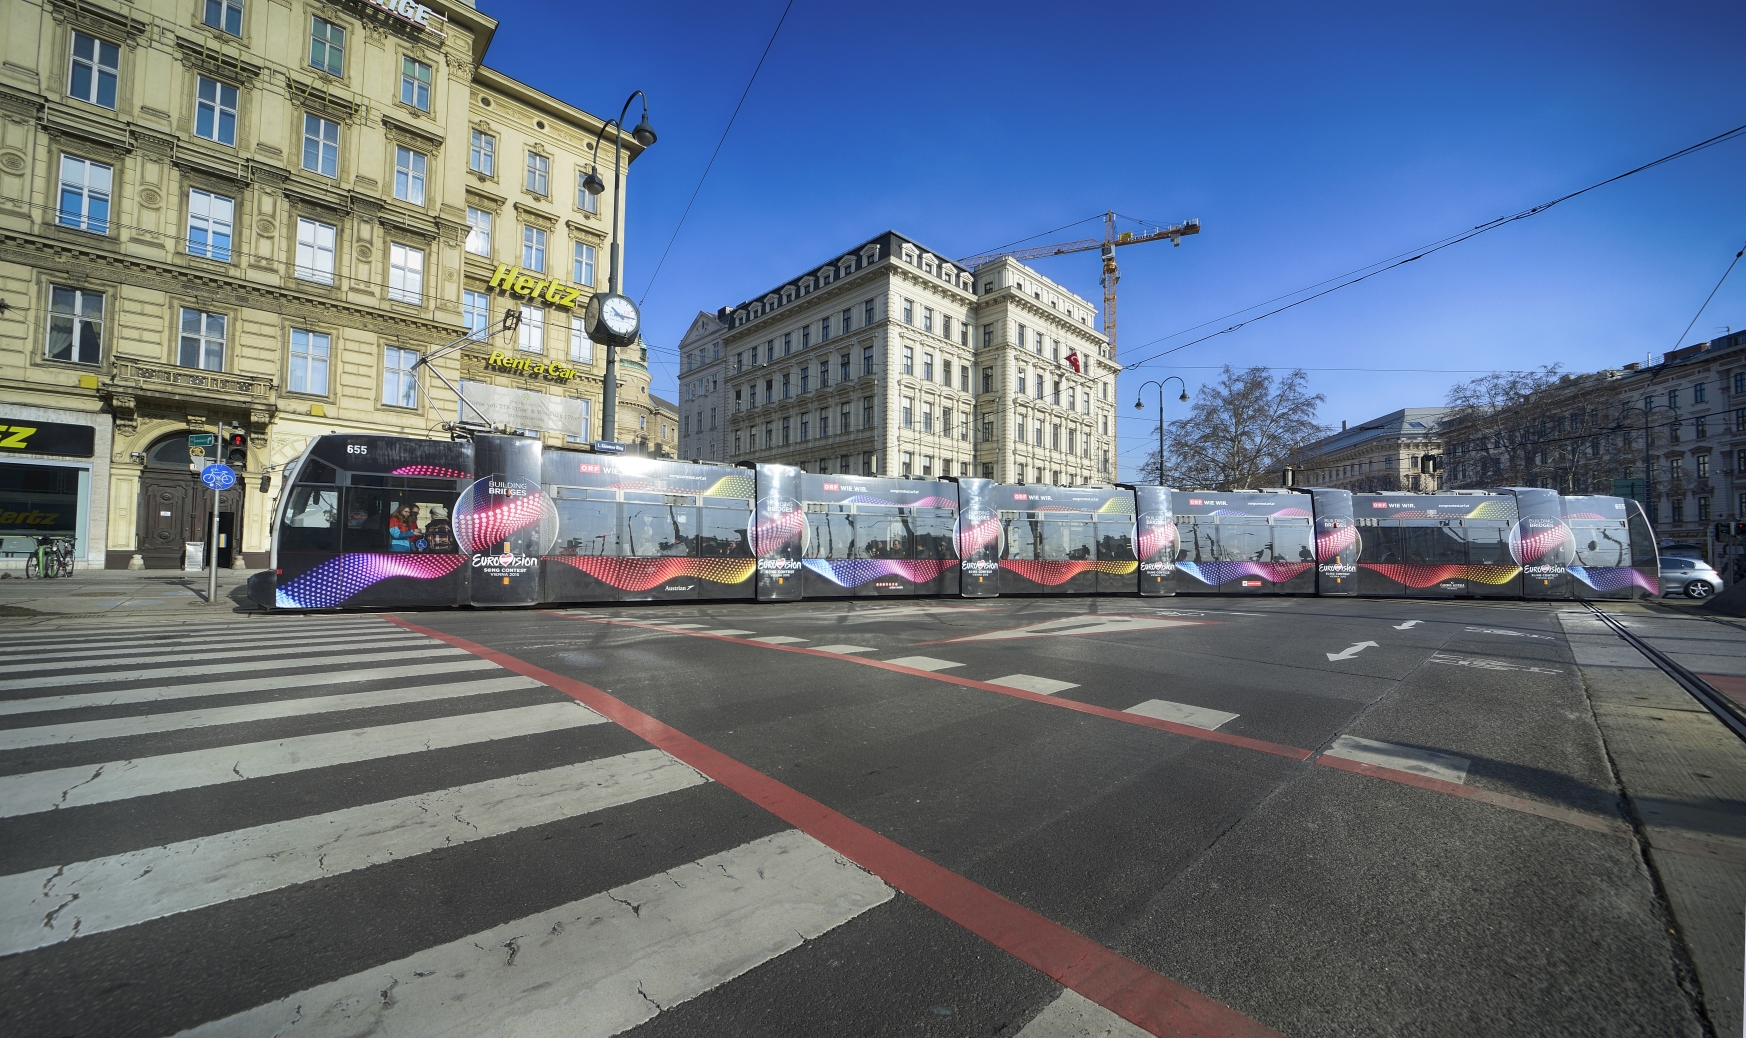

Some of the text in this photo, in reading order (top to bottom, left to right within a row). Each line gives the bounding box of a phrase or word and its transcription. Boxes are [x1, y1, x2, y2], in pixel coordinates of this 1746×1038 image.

[488, 263, 581, 308] Hertz
[488, 350, 578, 380] Rent a Car
[346, 444, 368, 455] 655
[581, 465, 600, 473] ORF
[488, 481, 527, 490] BUILDING
